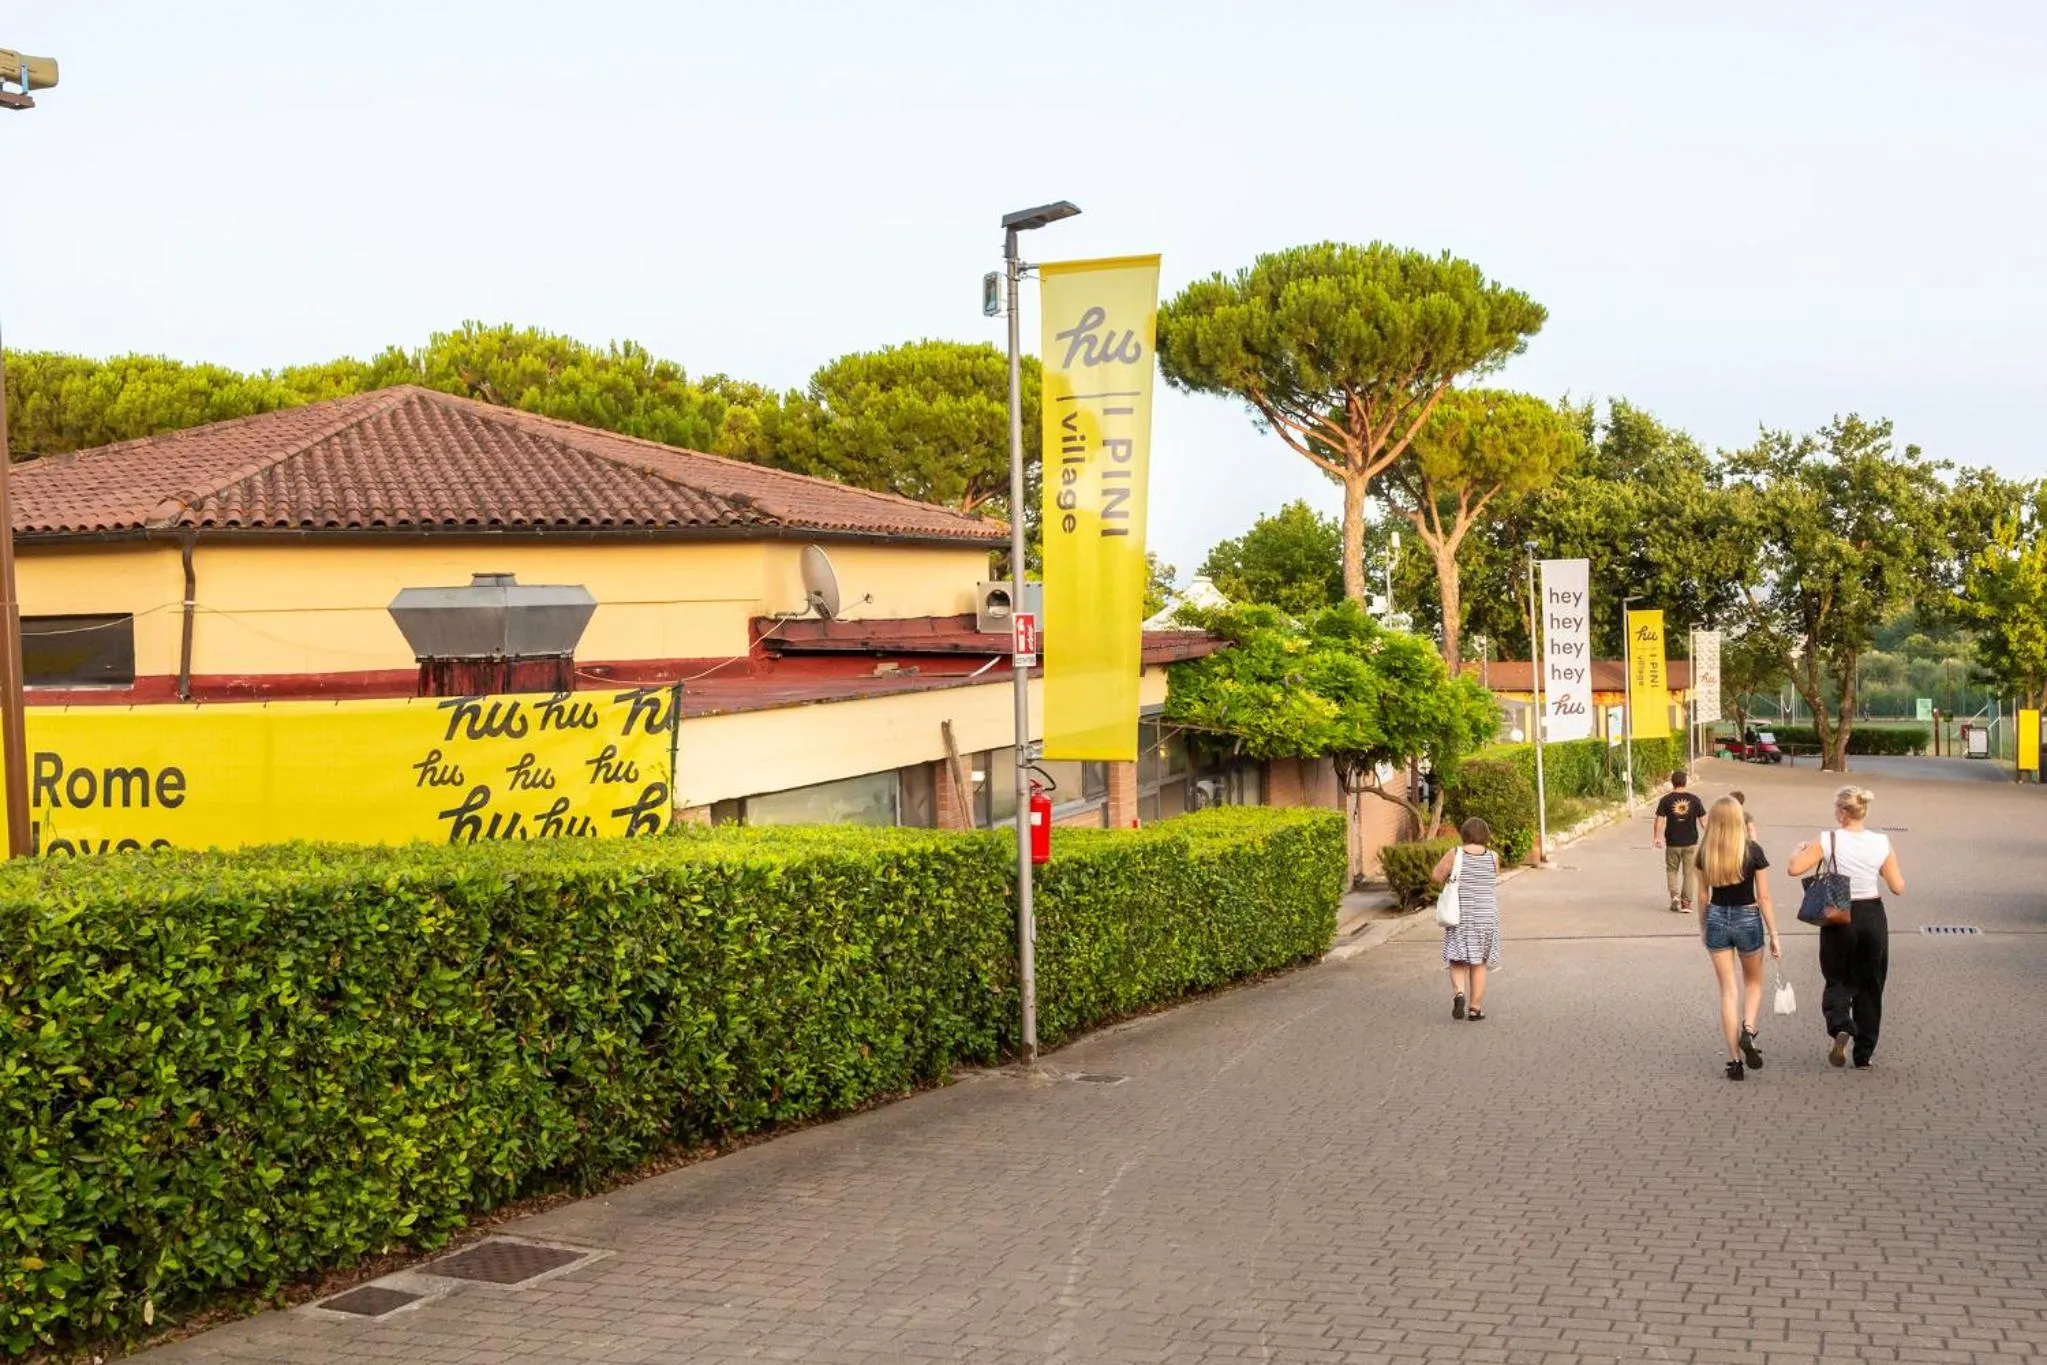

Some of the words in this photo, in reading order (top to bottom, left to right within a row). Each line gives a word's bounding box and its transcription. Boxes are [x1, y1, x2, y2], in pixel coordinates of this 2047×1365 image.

[1056, 306, 1141, 369] hu
[1103, 407, 1133, 416] I
[1056, 411, 1086, 534] village
[1101, 438, 1133, 537] PINI
[1549, 587, 1583, 608] hey
[1550, 612, 1583, 632] hey
[1551, 638, 1584, 658] hey
[1551, 663, 1585, 684] hey
[1552, 693, 1586, 715] hu
[412, 749, 465, 787] hu
[506, 753, 556, 791] hu
[585, 744, 639, 784] hu
[32, 752, 186, 808] Rome
